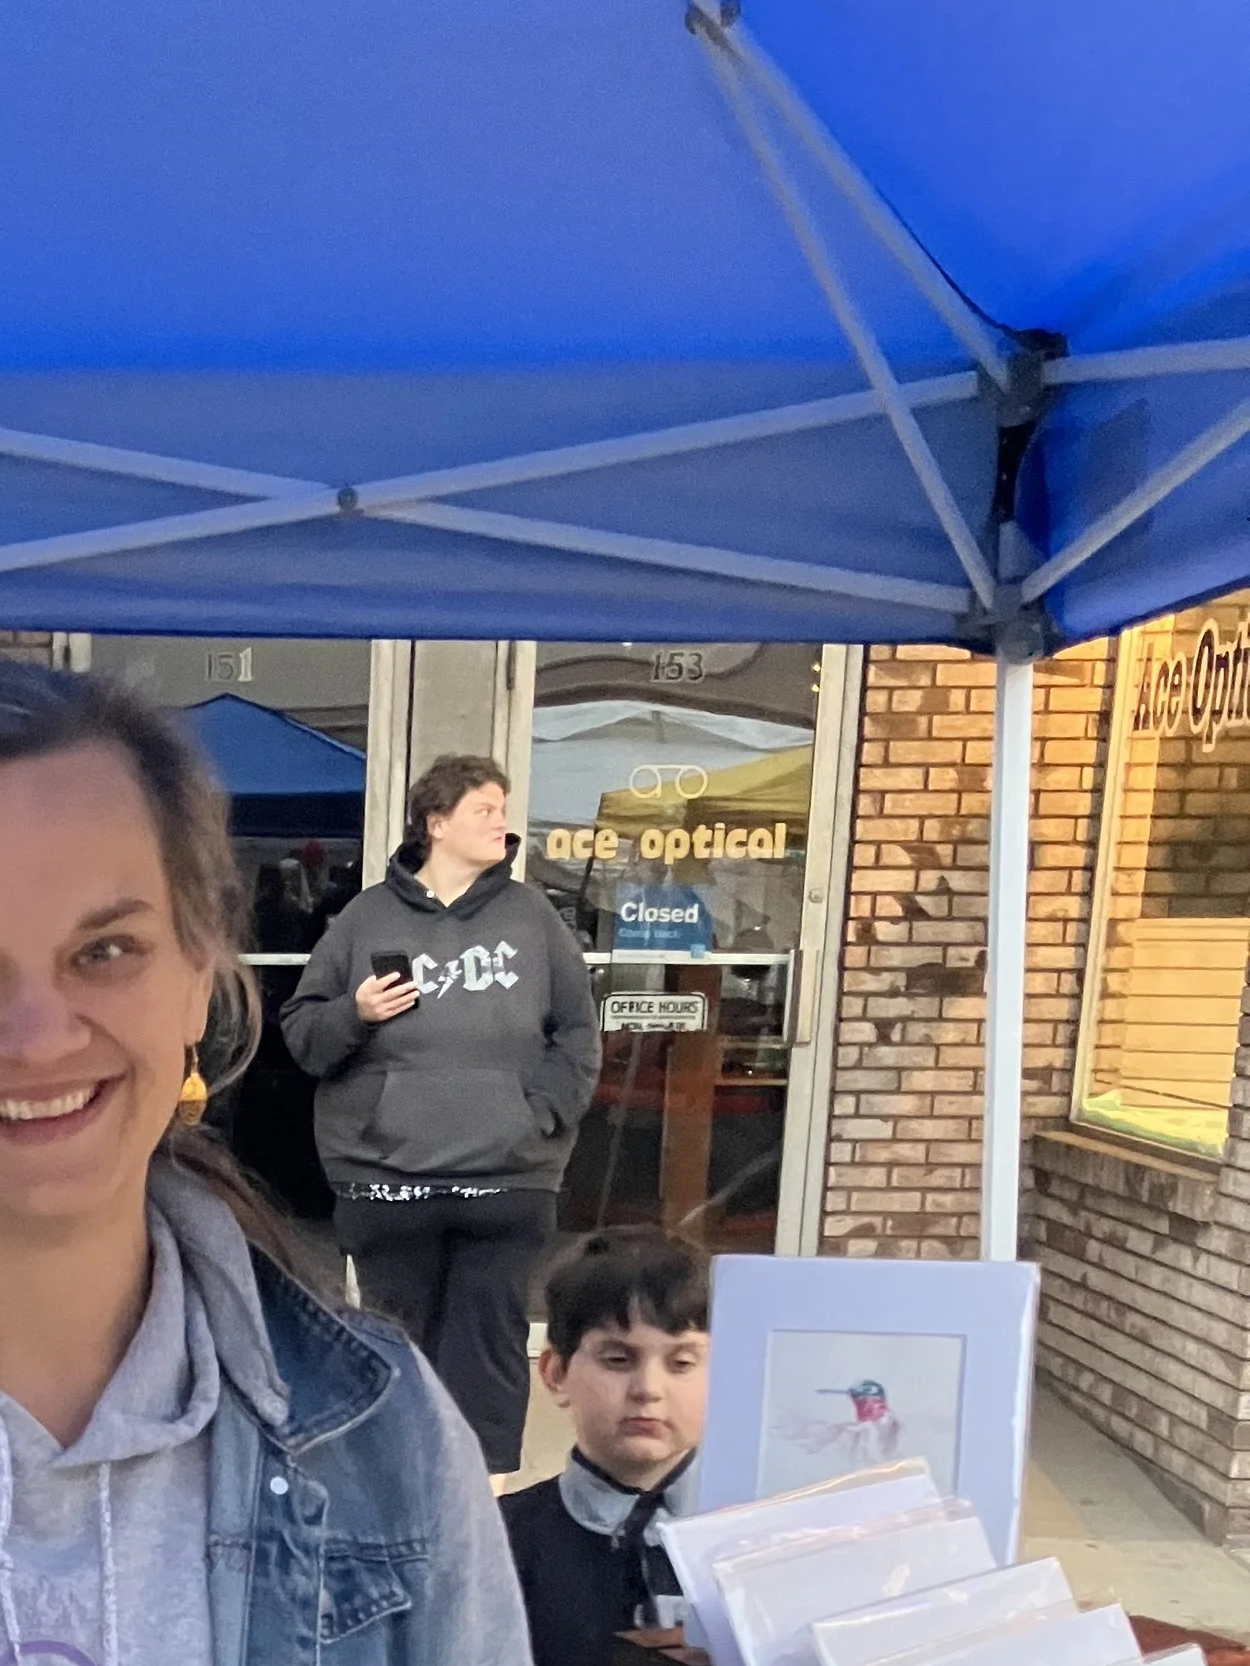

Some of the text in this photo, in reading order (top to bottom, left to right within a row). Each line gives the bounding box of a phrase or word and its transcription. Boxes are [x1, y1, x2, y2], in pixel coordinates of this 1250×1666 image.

[206, 647, 252, 682] 151
[653, 651, 704, 681] 153
[546, 822, 787, 865] ace optical
[620, 902, 699, 924] Closed
[610, 1001, 699, 1014] OFFICE HOURS
